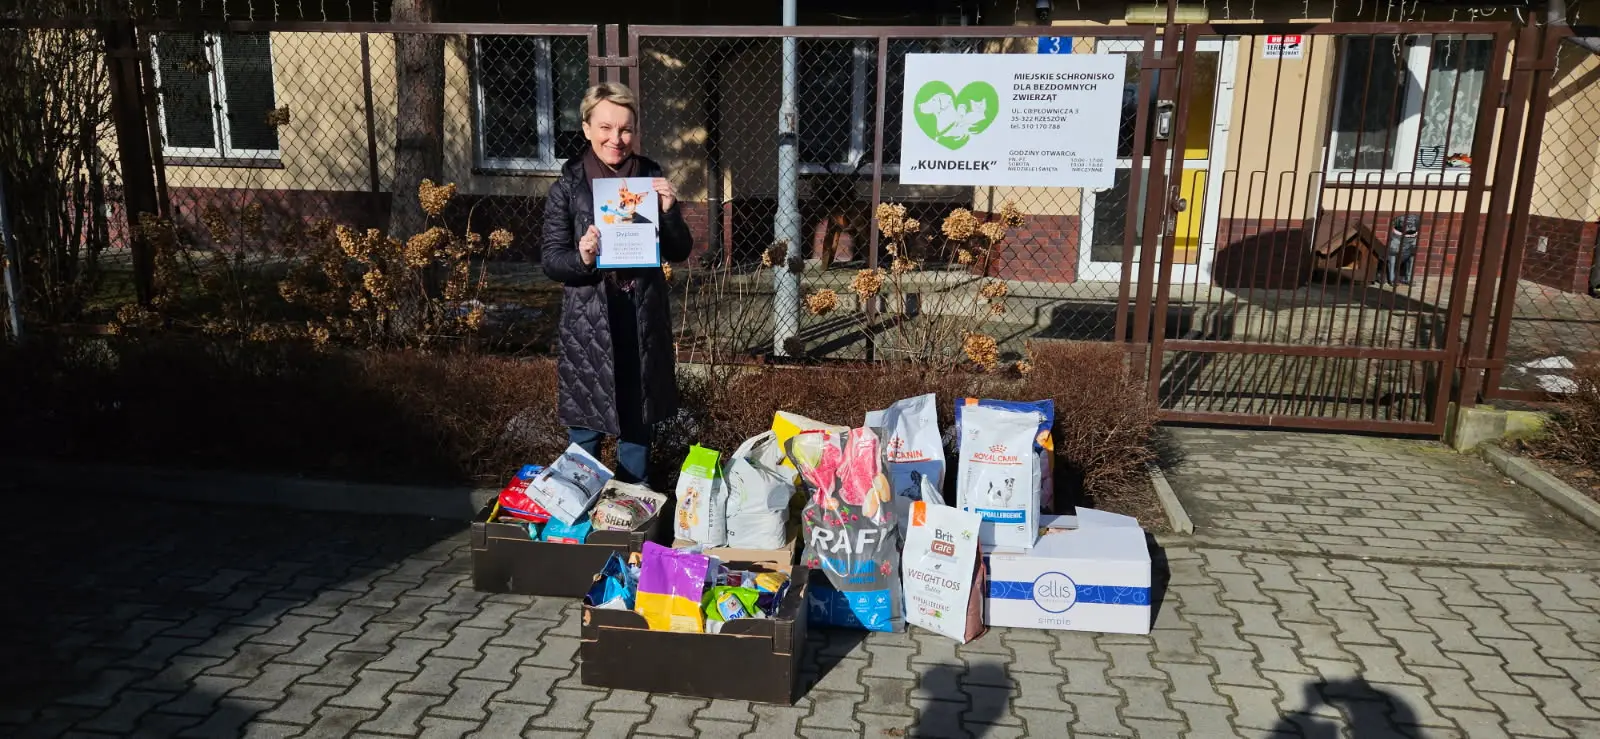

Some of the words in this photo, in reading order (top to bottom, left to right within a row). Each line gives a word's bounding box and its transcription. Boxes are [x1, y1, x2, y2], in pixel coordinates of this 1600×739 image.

[1050, 36, 1060, 53] 3
[1013, 83, 1031, 91] DLA
[1033, 83, 1097, 91] BEZDOMNYCH
[1012, 93, 1058, 102] ZWIERZĄT
[973, 452, 996, 461] ROYAL
[935, 529, 954, 542] Brit
[934, 543, 953, 554] care
[908, 568, 941, 586] WEIGHT
[941, 580, 961, 591] LOSS
[1038, 580, 1071, 598] ellis
[1038, 617, 1071, 626] simple
